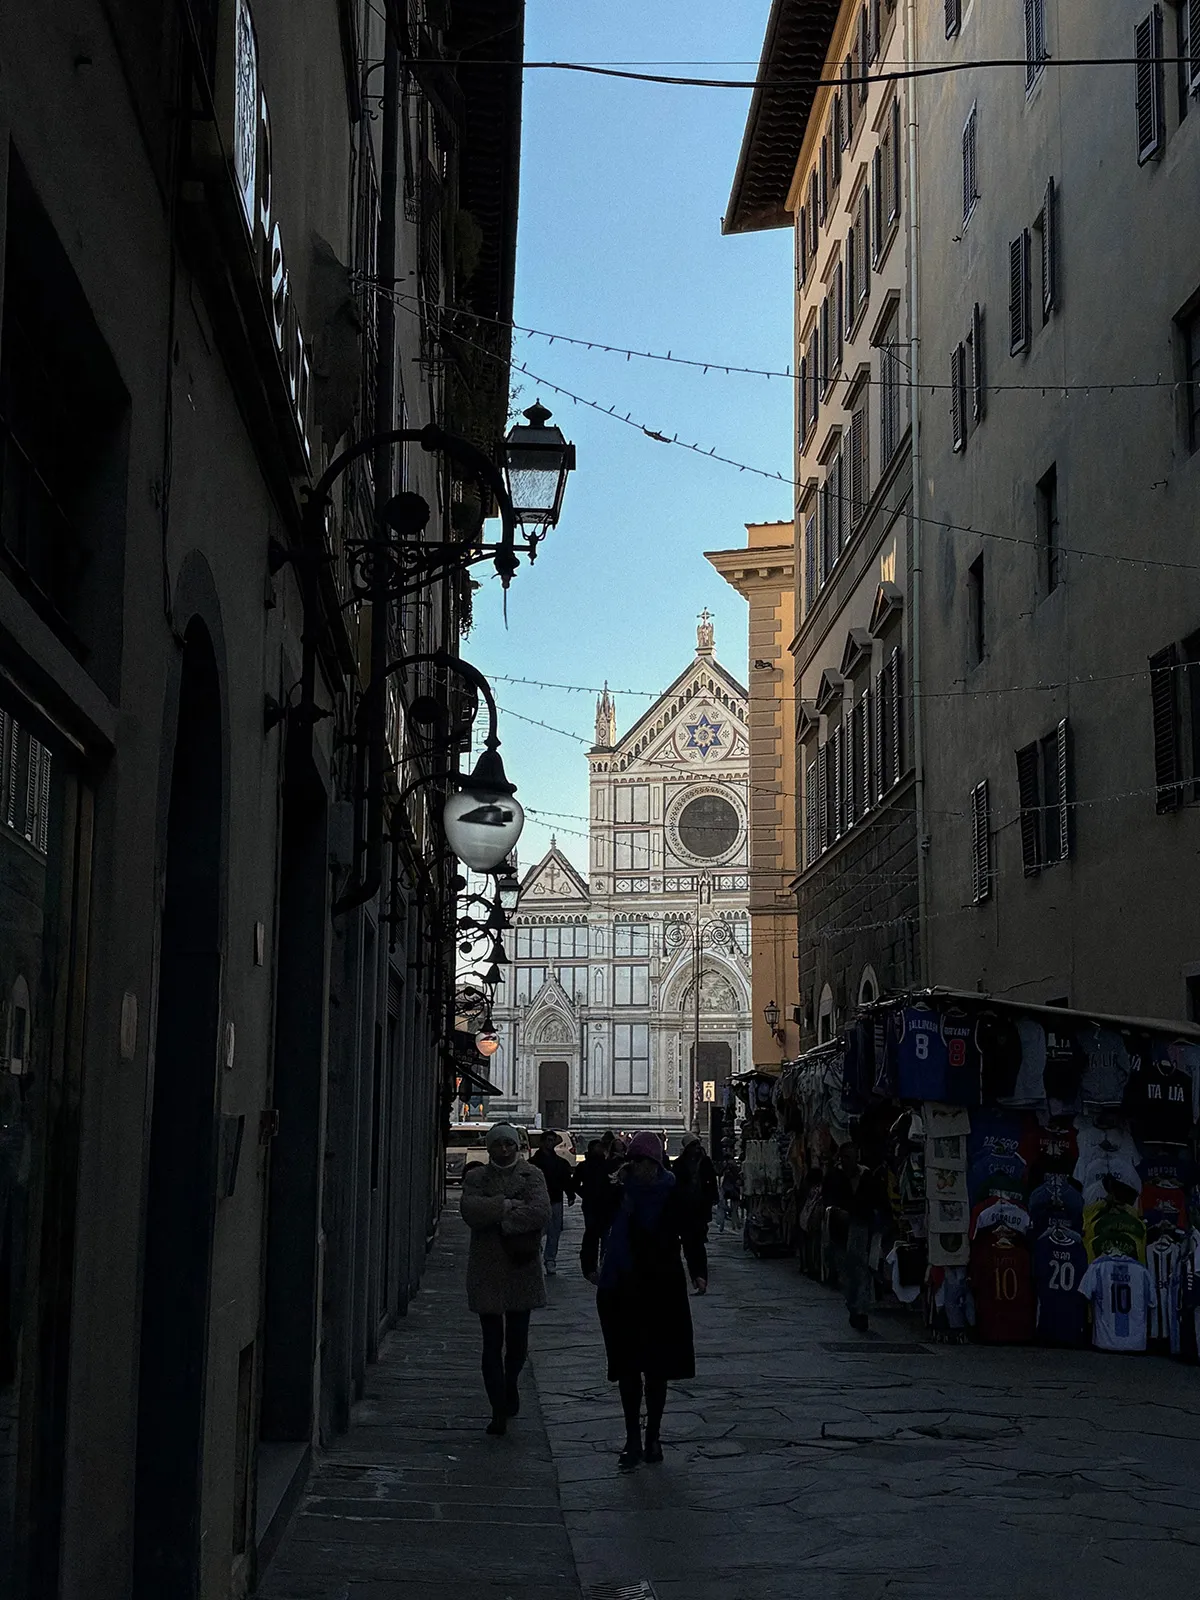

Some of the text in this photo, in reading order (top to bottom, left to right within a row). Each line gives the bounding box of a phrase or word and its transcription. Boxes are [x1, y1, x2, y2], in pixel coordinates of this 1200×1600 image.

[915, 1033, 929, 1060] 8
[948, 1038, 967, 1067] 8
[994, 1267, 1019, 1301] 10
[1048, 1260, 1075, 1292] 20
[1110, 1284, 1132, 1314] 10
